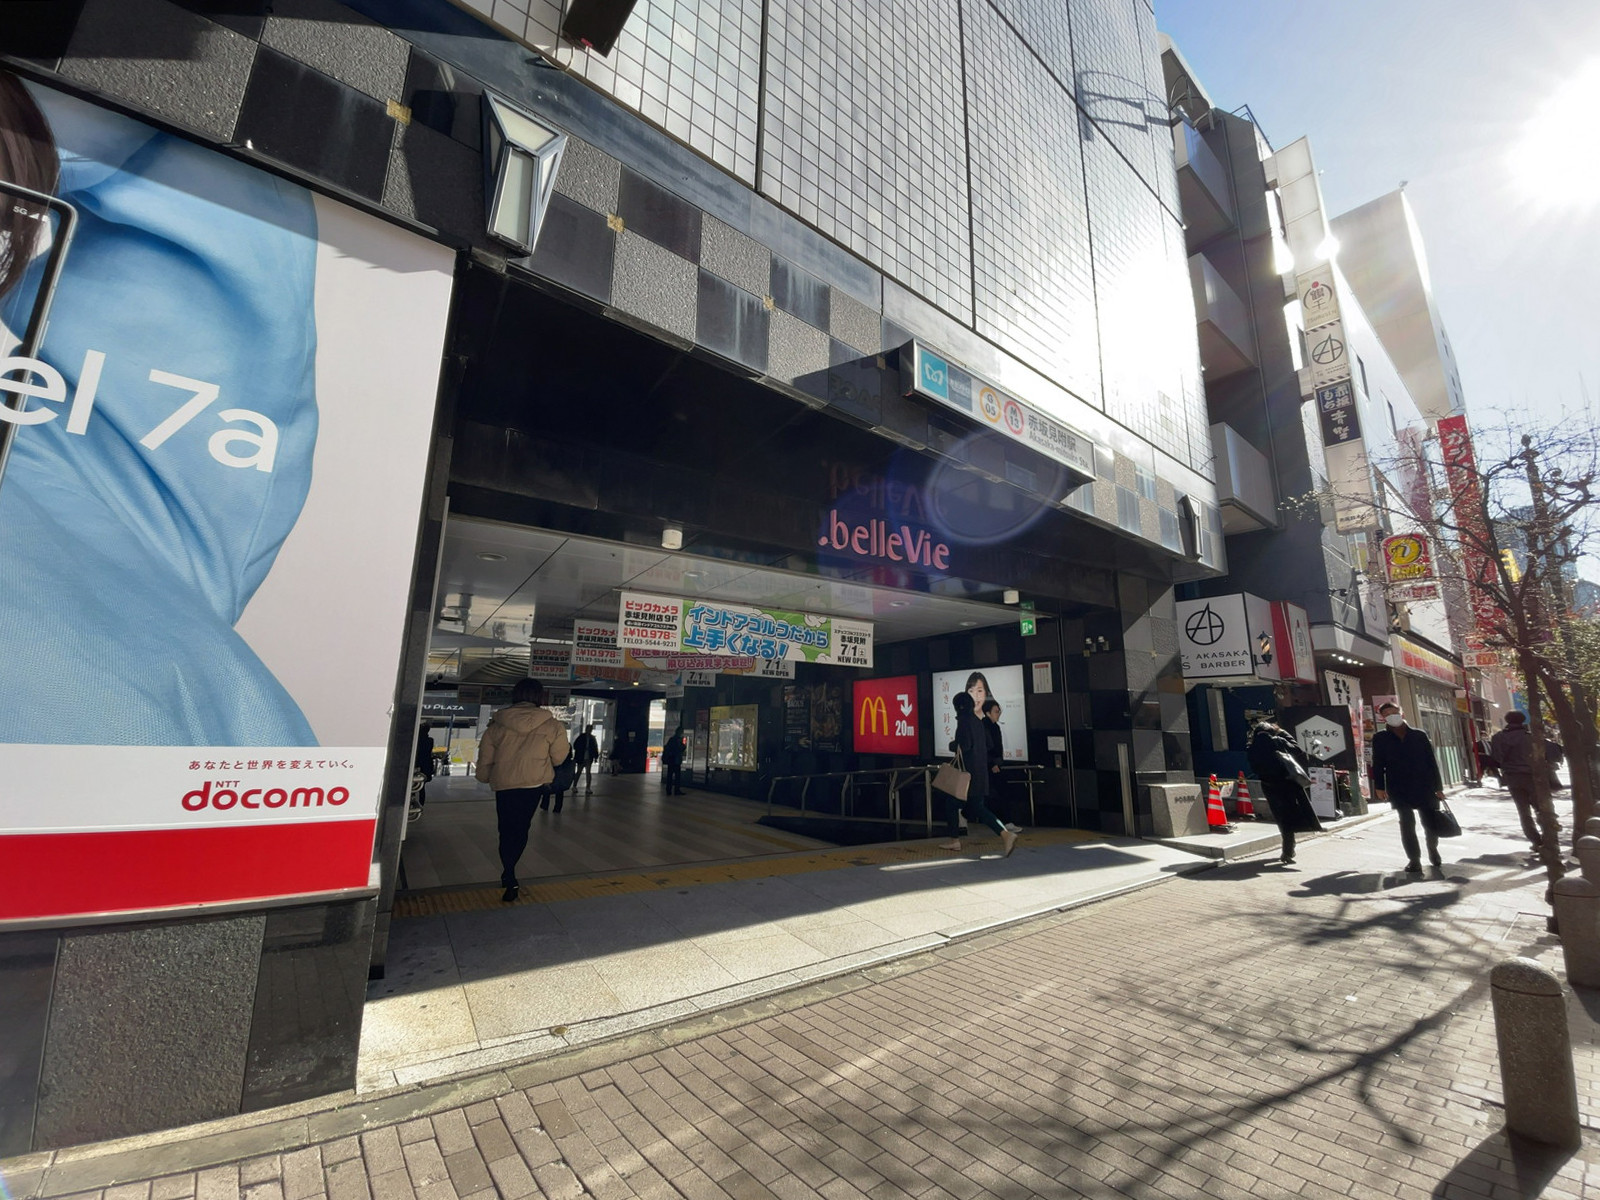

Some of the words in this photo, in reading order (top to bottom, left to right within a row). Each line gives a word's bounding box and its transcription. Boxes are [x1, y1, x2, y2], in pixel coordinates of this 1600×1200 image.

[12, 205, 28, 215] 5G
[985, 402, 996, 416] 05
[139, 369, 279, 473] 7a
[1027, 413, 1077, 453] 赤坂見附駅
[625, 600, 679, 614] ビックカメラ
[577, 626, 618, 637] ビックカメ
[689, 605, 829, 649] インドアゴルフだから
[840, 643, 858, 656] 7/1
[1195, 649, 1249, 660] AKASAKA
[852, 657, 868, 665] OPEN
[1200, 660, 1246, 669] BARBER
[433, 703, 465, 711] PLAZA
[895, 720, 915, 737] 20m
[188, 759, 355, 771] あなたと世界を変えていく。
[215, 780, 241, 789] NTT
[181, 781, 350, 812] docomo
